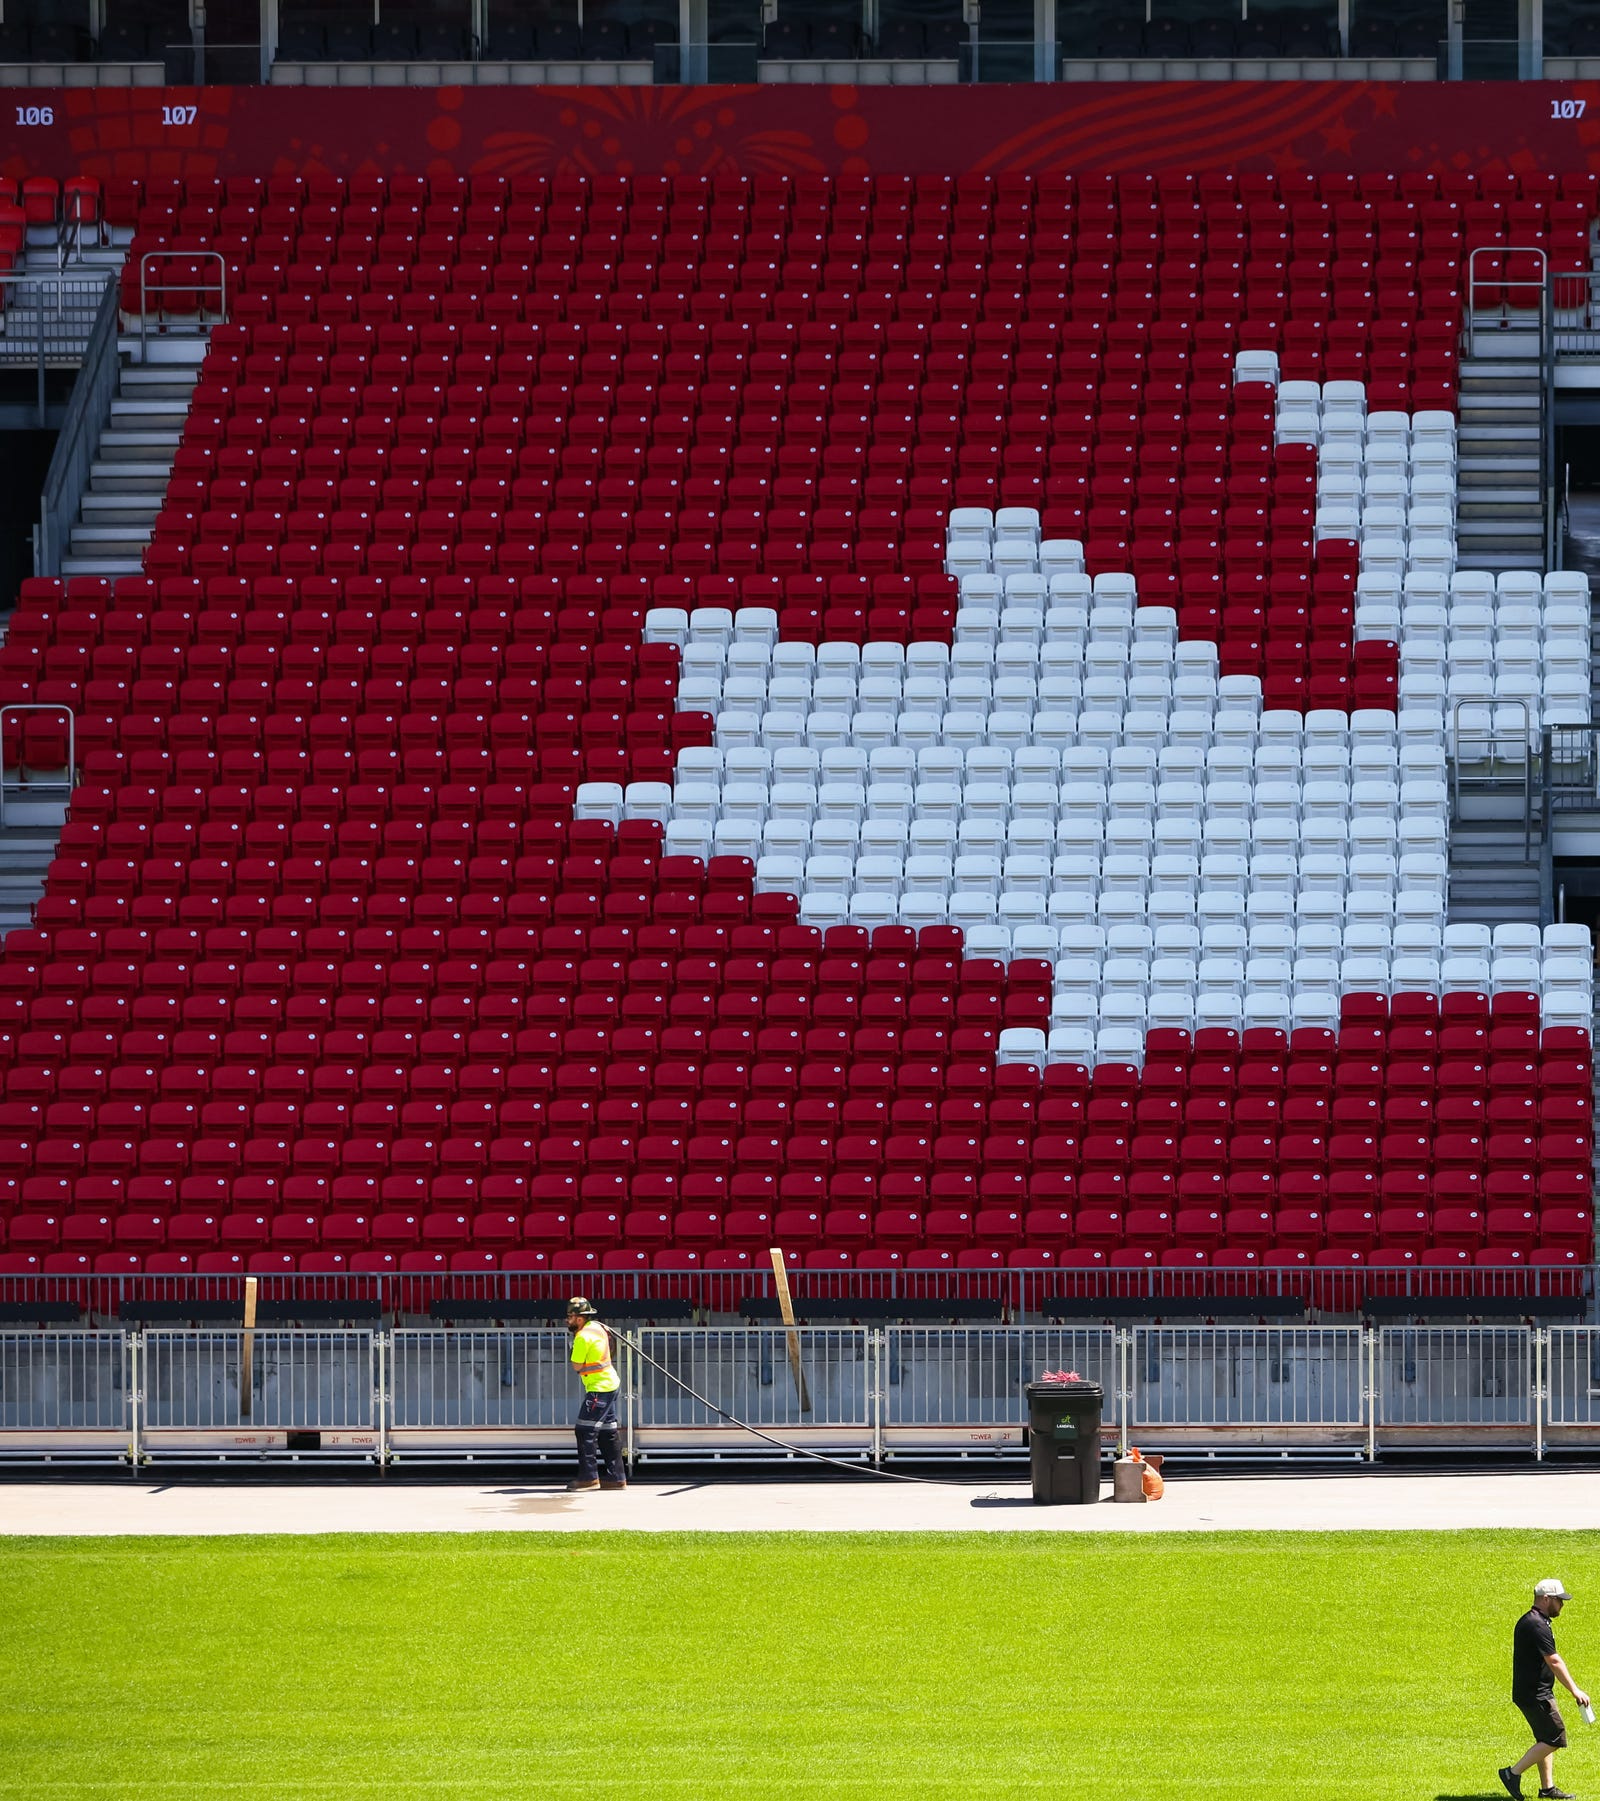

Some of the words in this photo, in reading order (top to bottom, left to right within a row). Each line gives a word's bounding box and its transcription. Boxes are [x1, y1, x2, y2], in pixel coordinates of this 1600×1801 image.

[15, 106, 55, 126] 106
[161, 105, 198, 126] 107
[1550, 99, 1587, 119] 107
